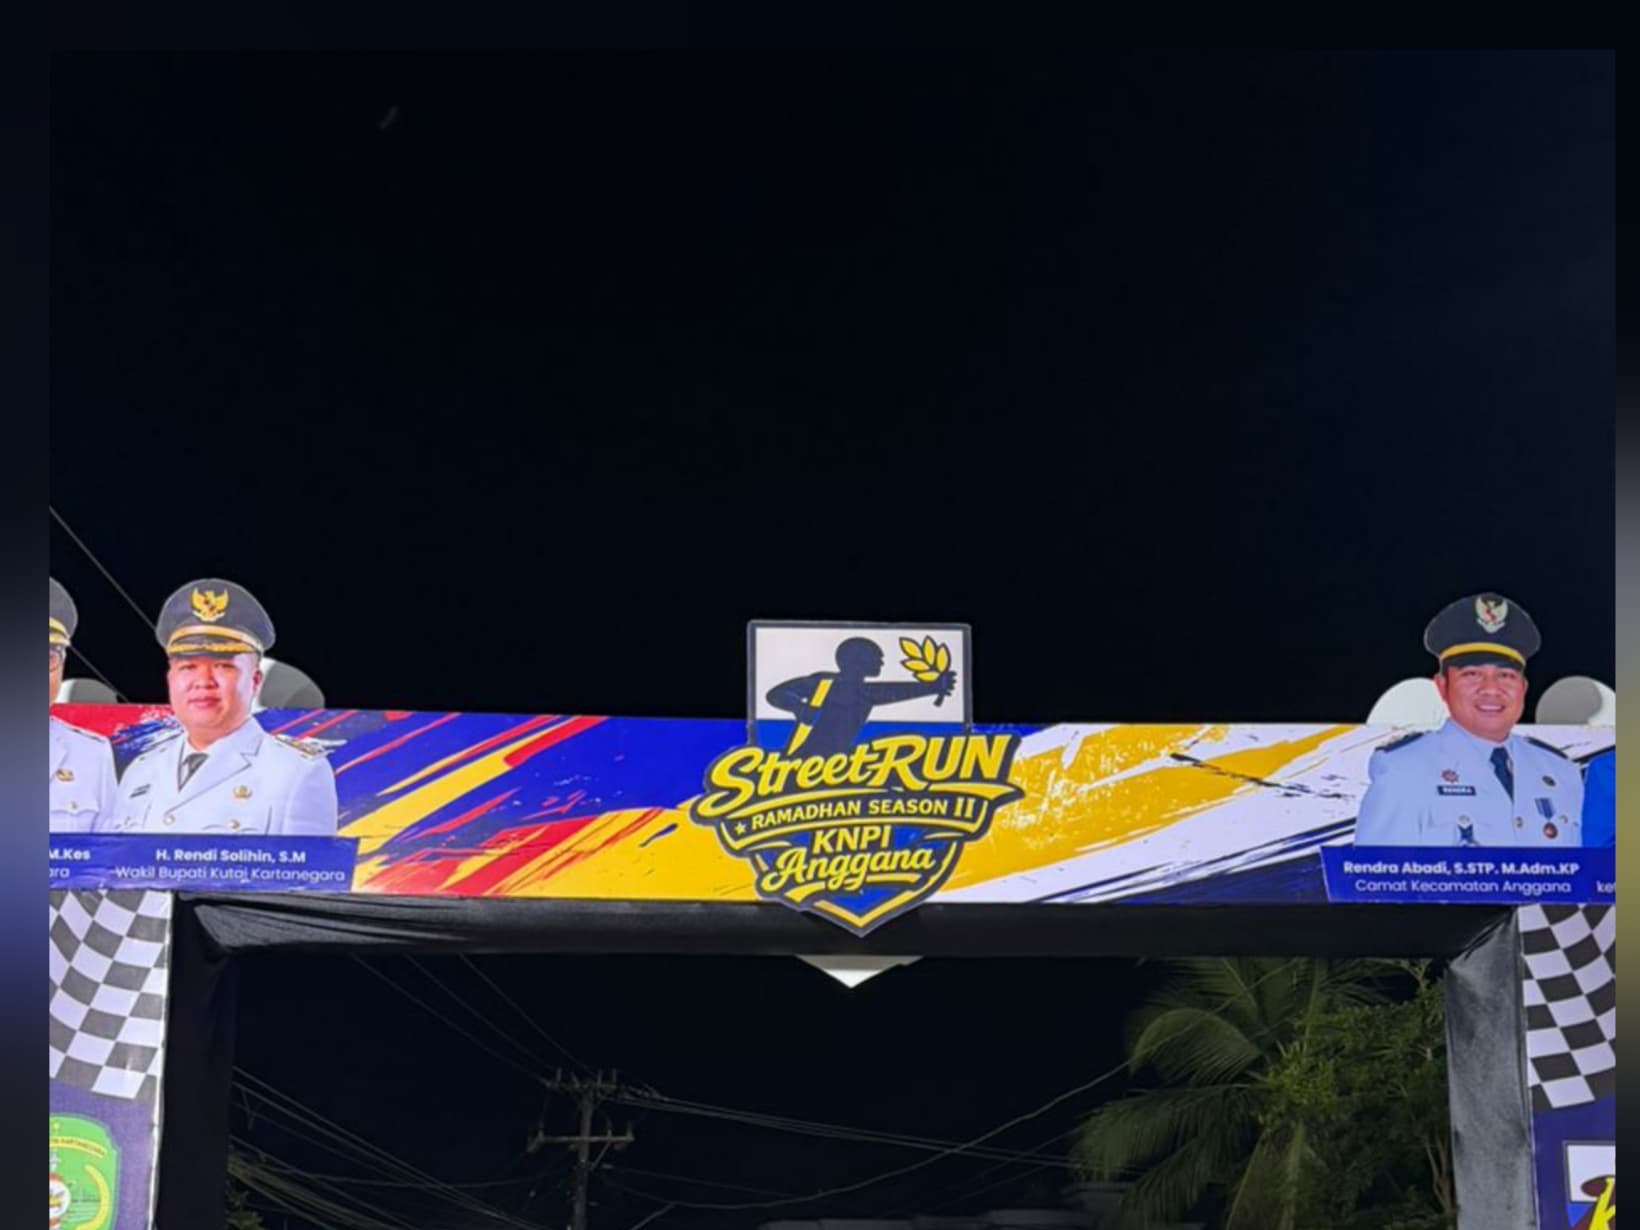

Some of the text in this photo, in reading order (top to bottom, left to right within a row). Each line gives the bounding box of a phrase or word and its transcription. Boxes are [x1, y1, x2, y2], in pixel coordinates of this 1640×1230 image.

[751, 797, 975, 831] RAMADHAN SEASON II
[812, 825, 893, 854] KNPI
[174, 848, 218, 861] Rendi
[279, 850, 306, 863] S.M
[115, 866, 155, 879] Wakil
[158, 866, 207, 881] Bupati
[251, 868, 345, 883] Kartanegara
[761, 847, 936, 891] Anggana
[1343, 861, 1399, 874] Rendra
[1355, 880, 1572, 896] Camat Kecamatan Anggana
